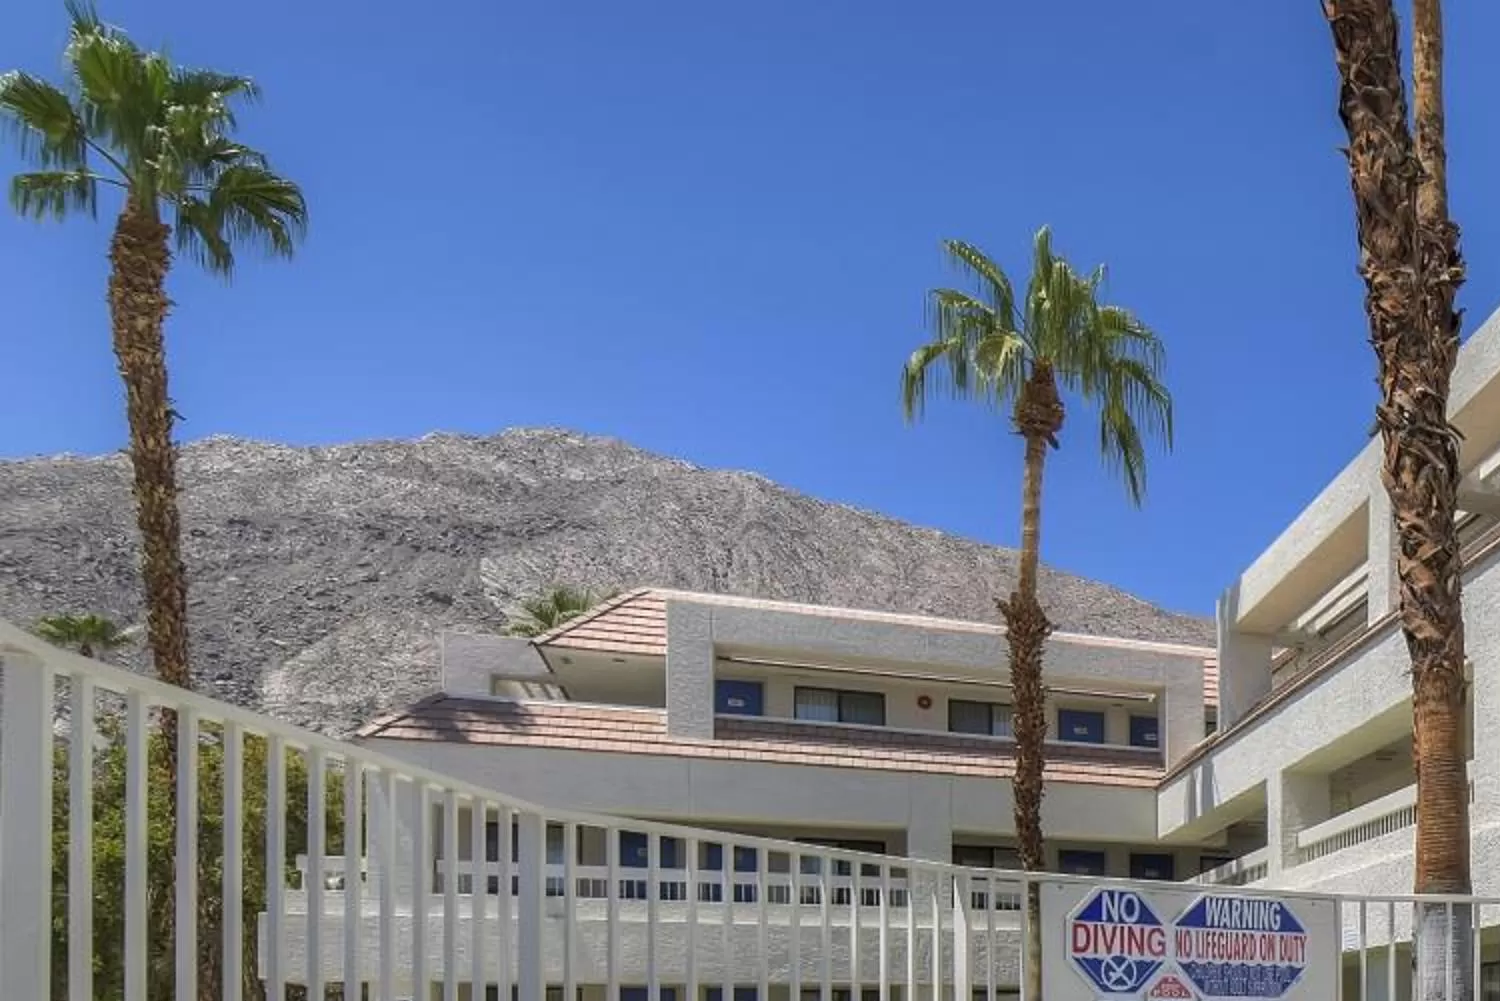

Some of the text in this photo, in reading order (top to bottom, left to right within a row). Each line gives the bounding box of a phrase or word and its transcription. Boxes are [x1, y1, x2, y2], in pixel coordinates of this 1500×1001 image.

[1102, 890, 1139, 922] NO
[1205, 898, 1281, 930] WARNING
[1072, 923, 1166, 957] DIVING
[1175, 929, 1307, 962] NO LIFEGUARD ON DUTY
[1153, 989, 1188, 997] POOL
